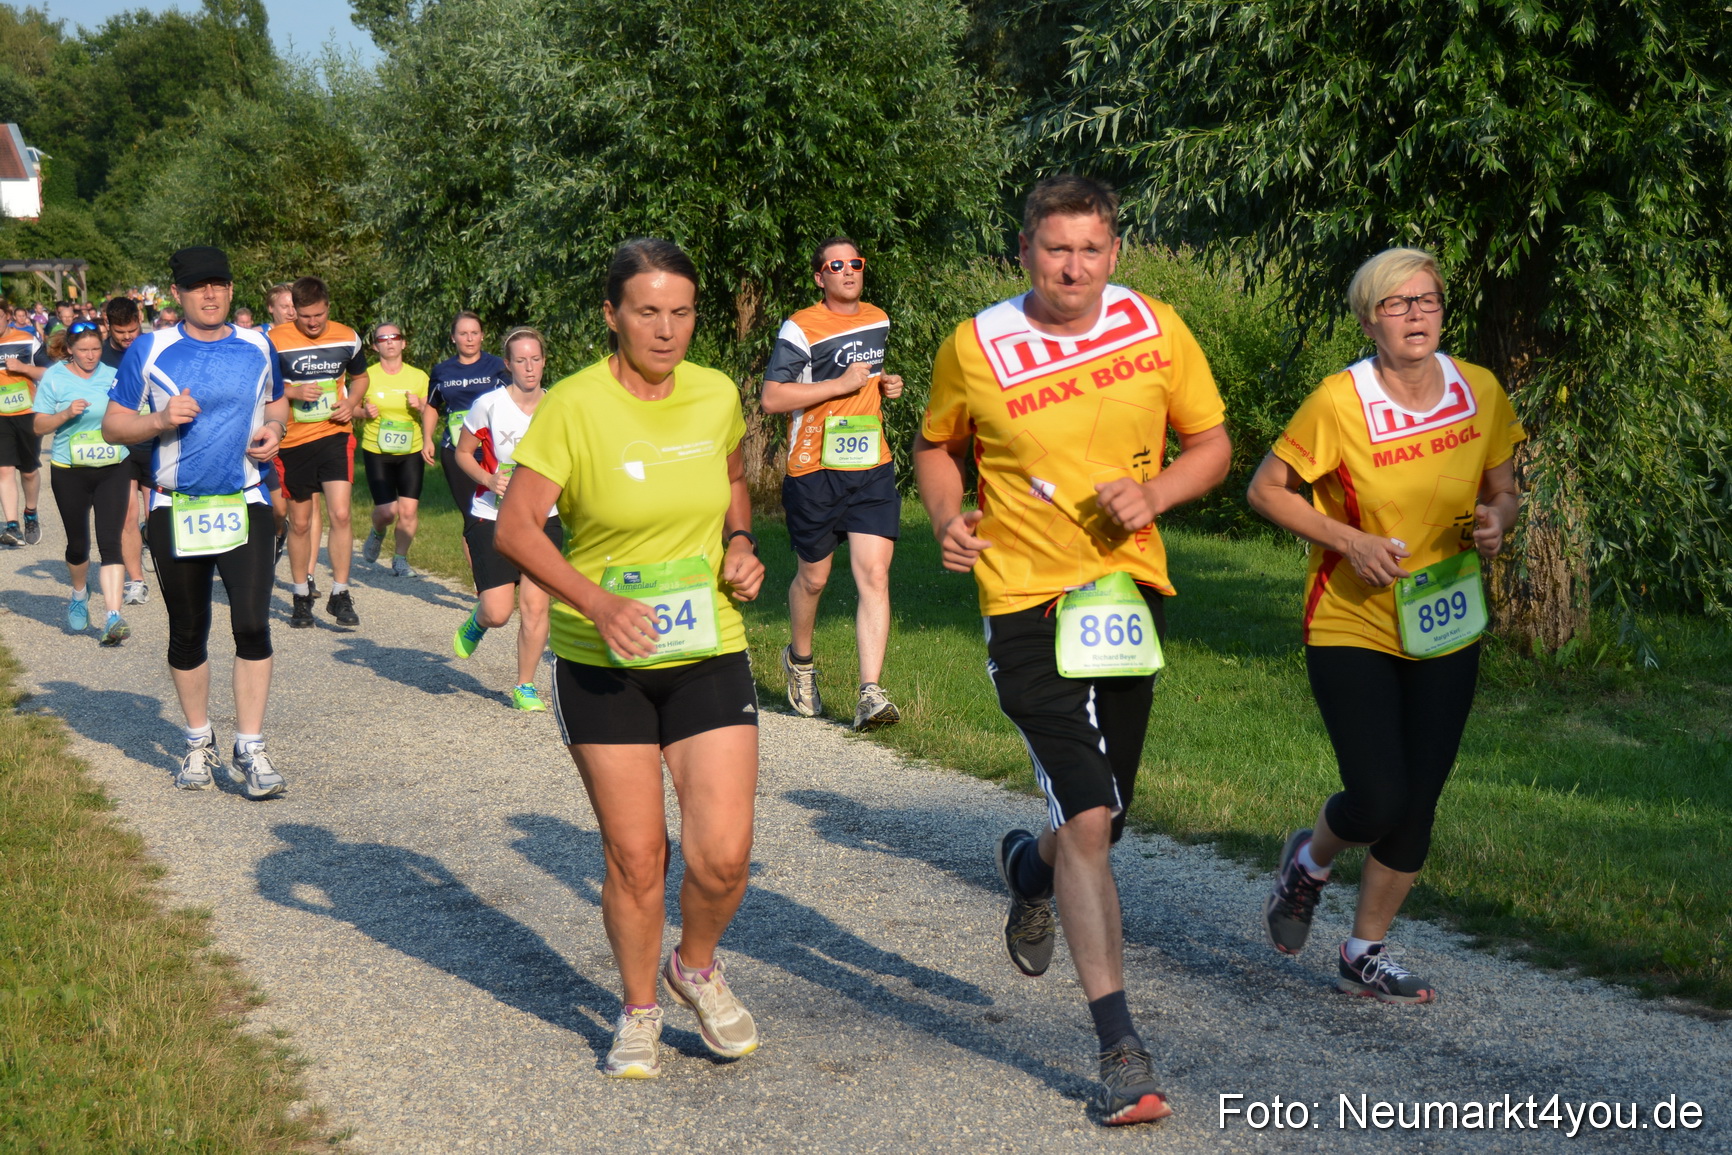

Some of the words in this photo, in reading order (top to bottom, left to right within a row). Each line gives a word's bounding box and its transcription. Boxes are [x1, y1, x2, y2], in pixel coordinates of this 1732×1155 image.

[301, 361, 342, 371] Fischer
[468, 376, 491, 385] POLES
[1006, 378, 1084, 419] MAX
[1090, 350, 1172, 389] BÖGL
[4, 393, 25, 405] 446
[219, 396, 239, 419] Dich
[384, 432, 407, 445] 679
[835, 436, 869, 454] 396
[1372, 442, 1425, 468] MAX
[1431, 425, 1481, 455] BÖGL
[77, 446, 116, 460] 1429
[183, 512, 242, 535] 1543
[617, 580, 657, 592] firmenlauf
[646, 599, 697, 635] 64
[1418, 591, 1467, 633] 899
[1080, 613, 1143, 647] 866
[1092, 654, 1119, 662] Richard
[1120, 653, 1137, 662] Beyer
